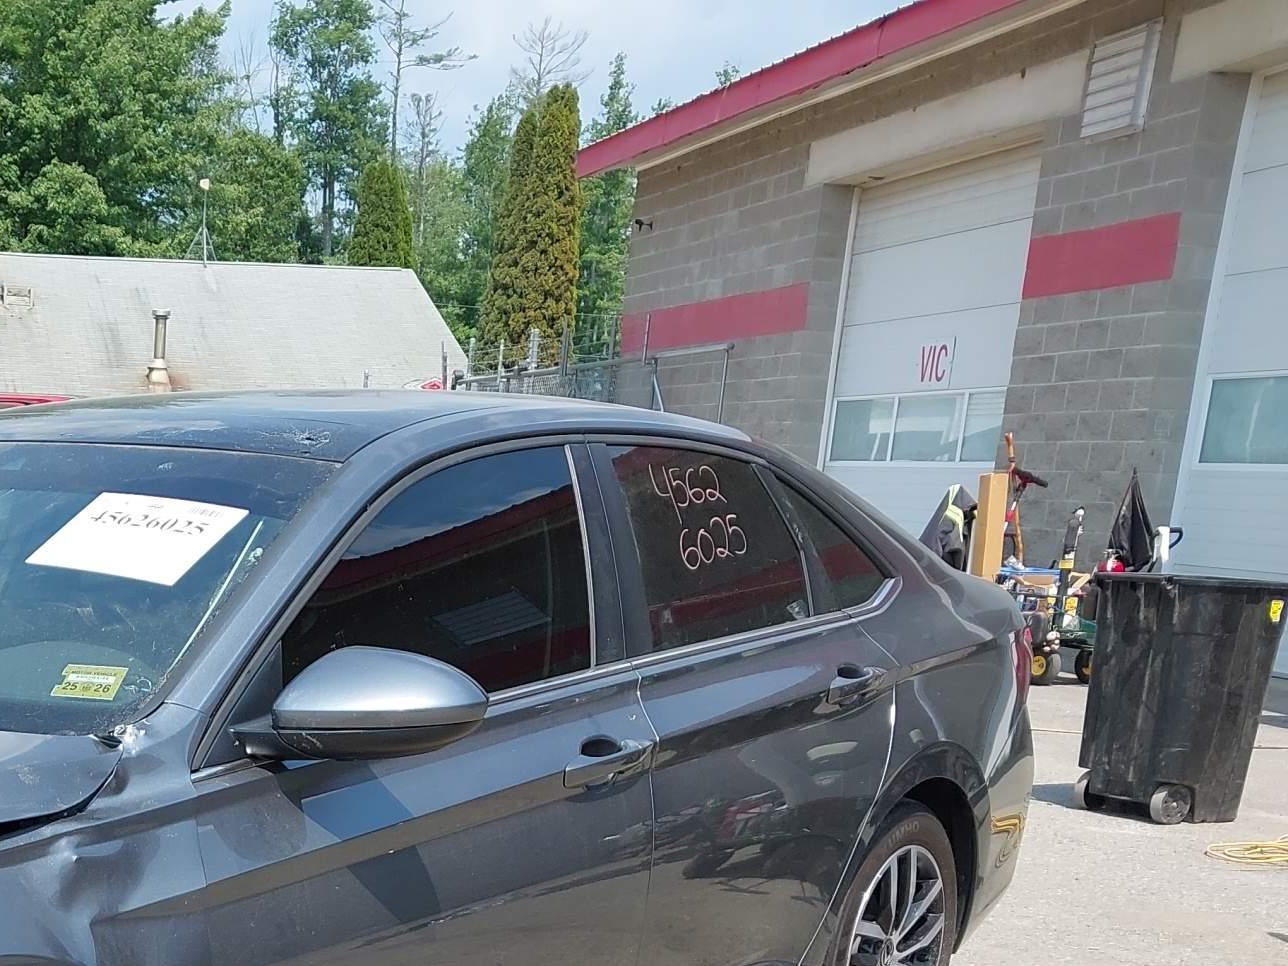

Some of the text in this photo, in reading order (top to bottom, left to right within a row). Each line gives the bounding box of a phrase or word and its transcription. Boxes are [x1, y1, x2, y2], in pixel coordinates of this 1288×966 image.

[920, 343, 948, 383] VIC
[648, 463, 728, 526] 4562
[89, 509, 211, 536] 45626025
[679, 513, 747, 570] 6025
[62, 681, 78, 691] 25
[93, 683, 112, 693] 26
